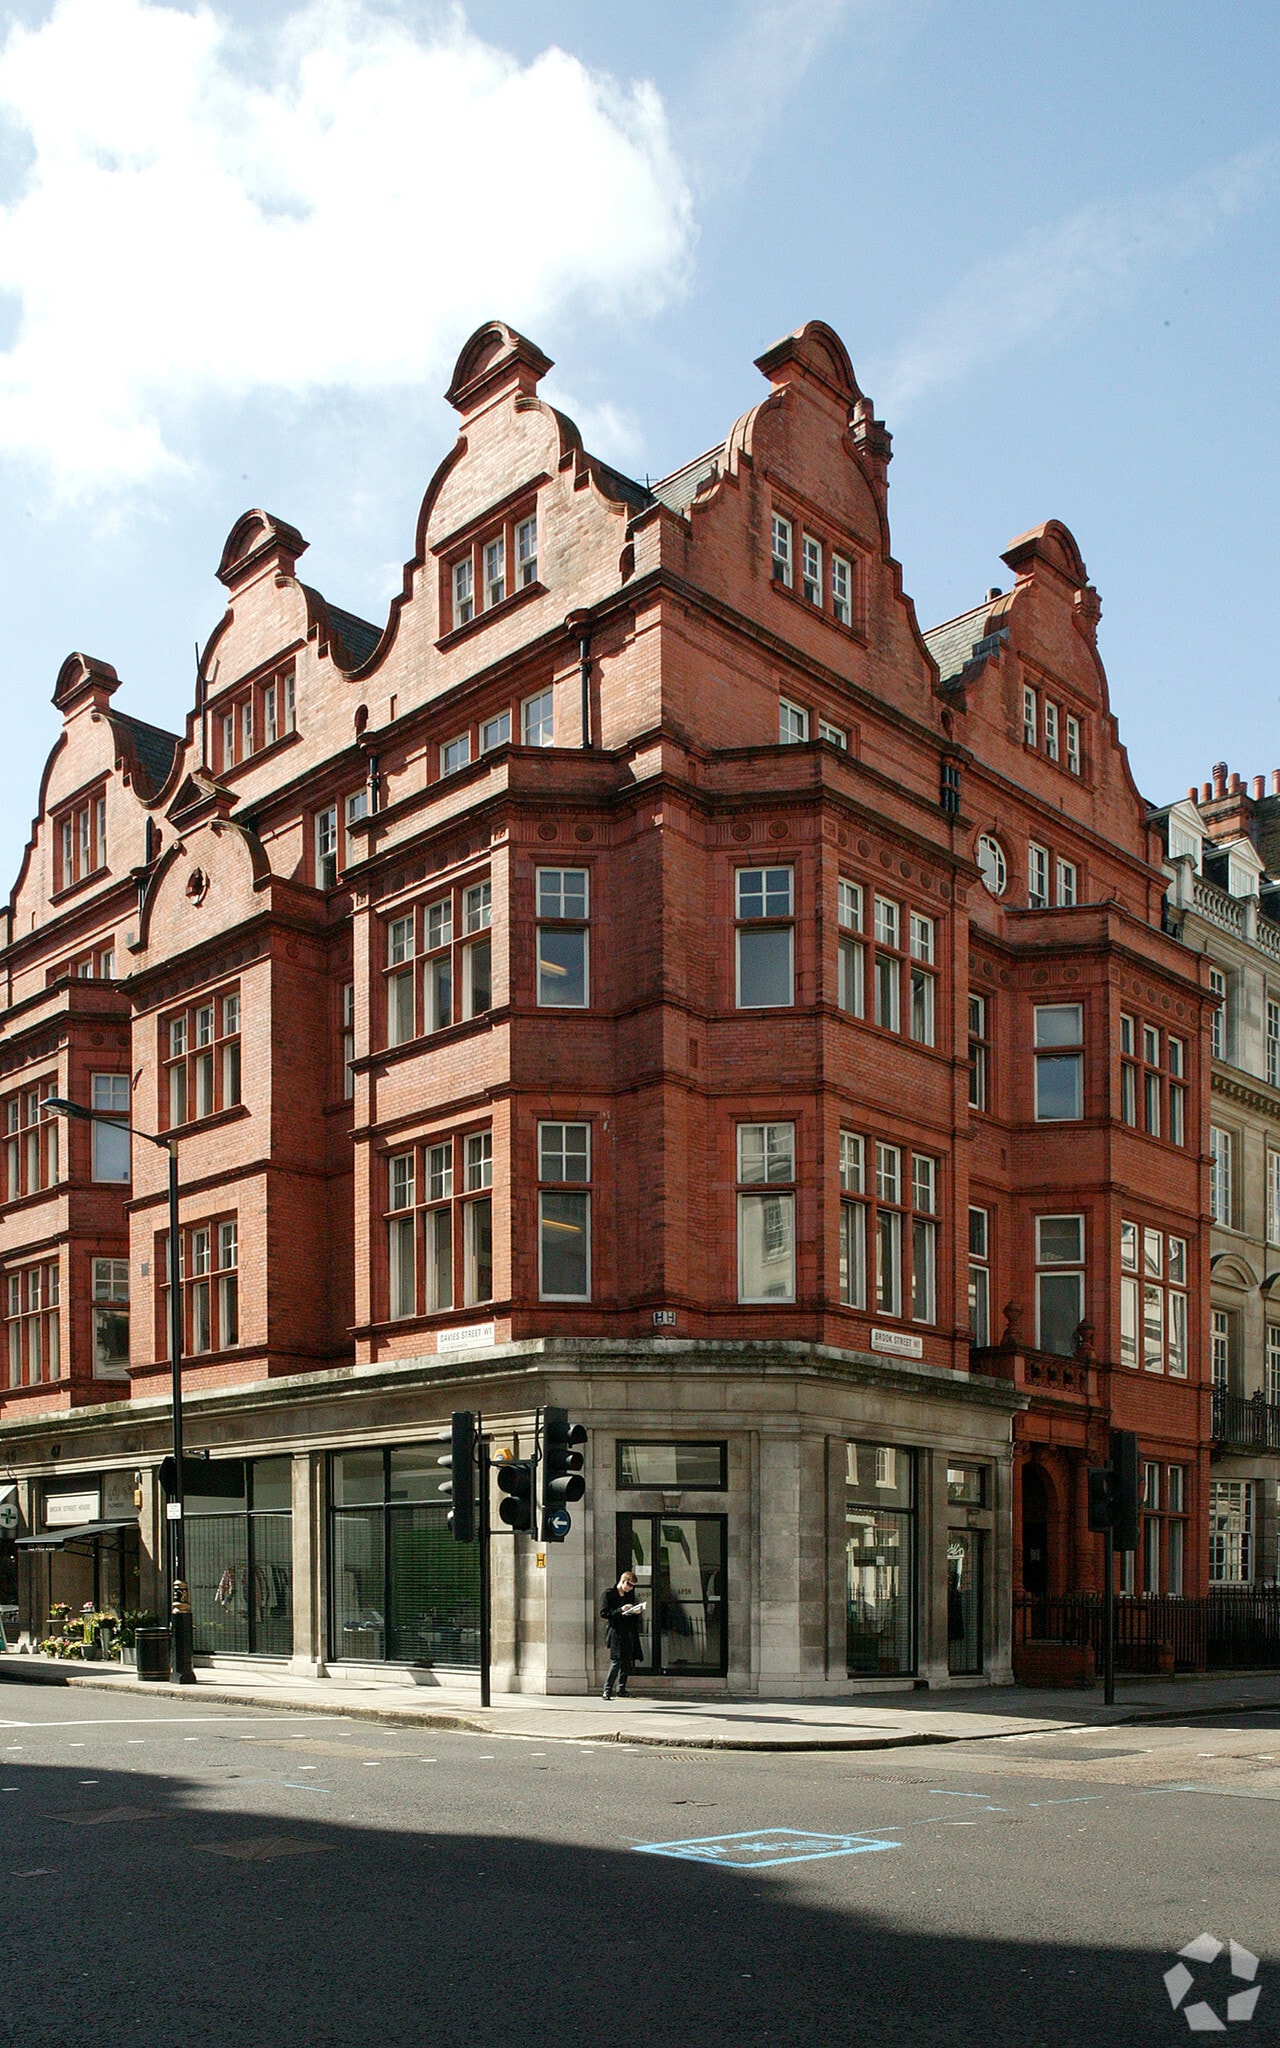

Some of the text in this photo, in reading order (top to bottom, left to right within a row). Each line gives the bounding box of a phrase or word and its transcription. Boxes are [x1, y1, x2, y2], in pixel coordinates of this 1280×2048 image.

[440, 1327, 492, 1343] DAVIES STREET W1
[875, 1332, 892, 1343] BROOK
[893, 1336, 912, 1347] STREET
[63, 1504, 77, 1512] STREET
[78, 1503, 91, 1511] HOUSE
